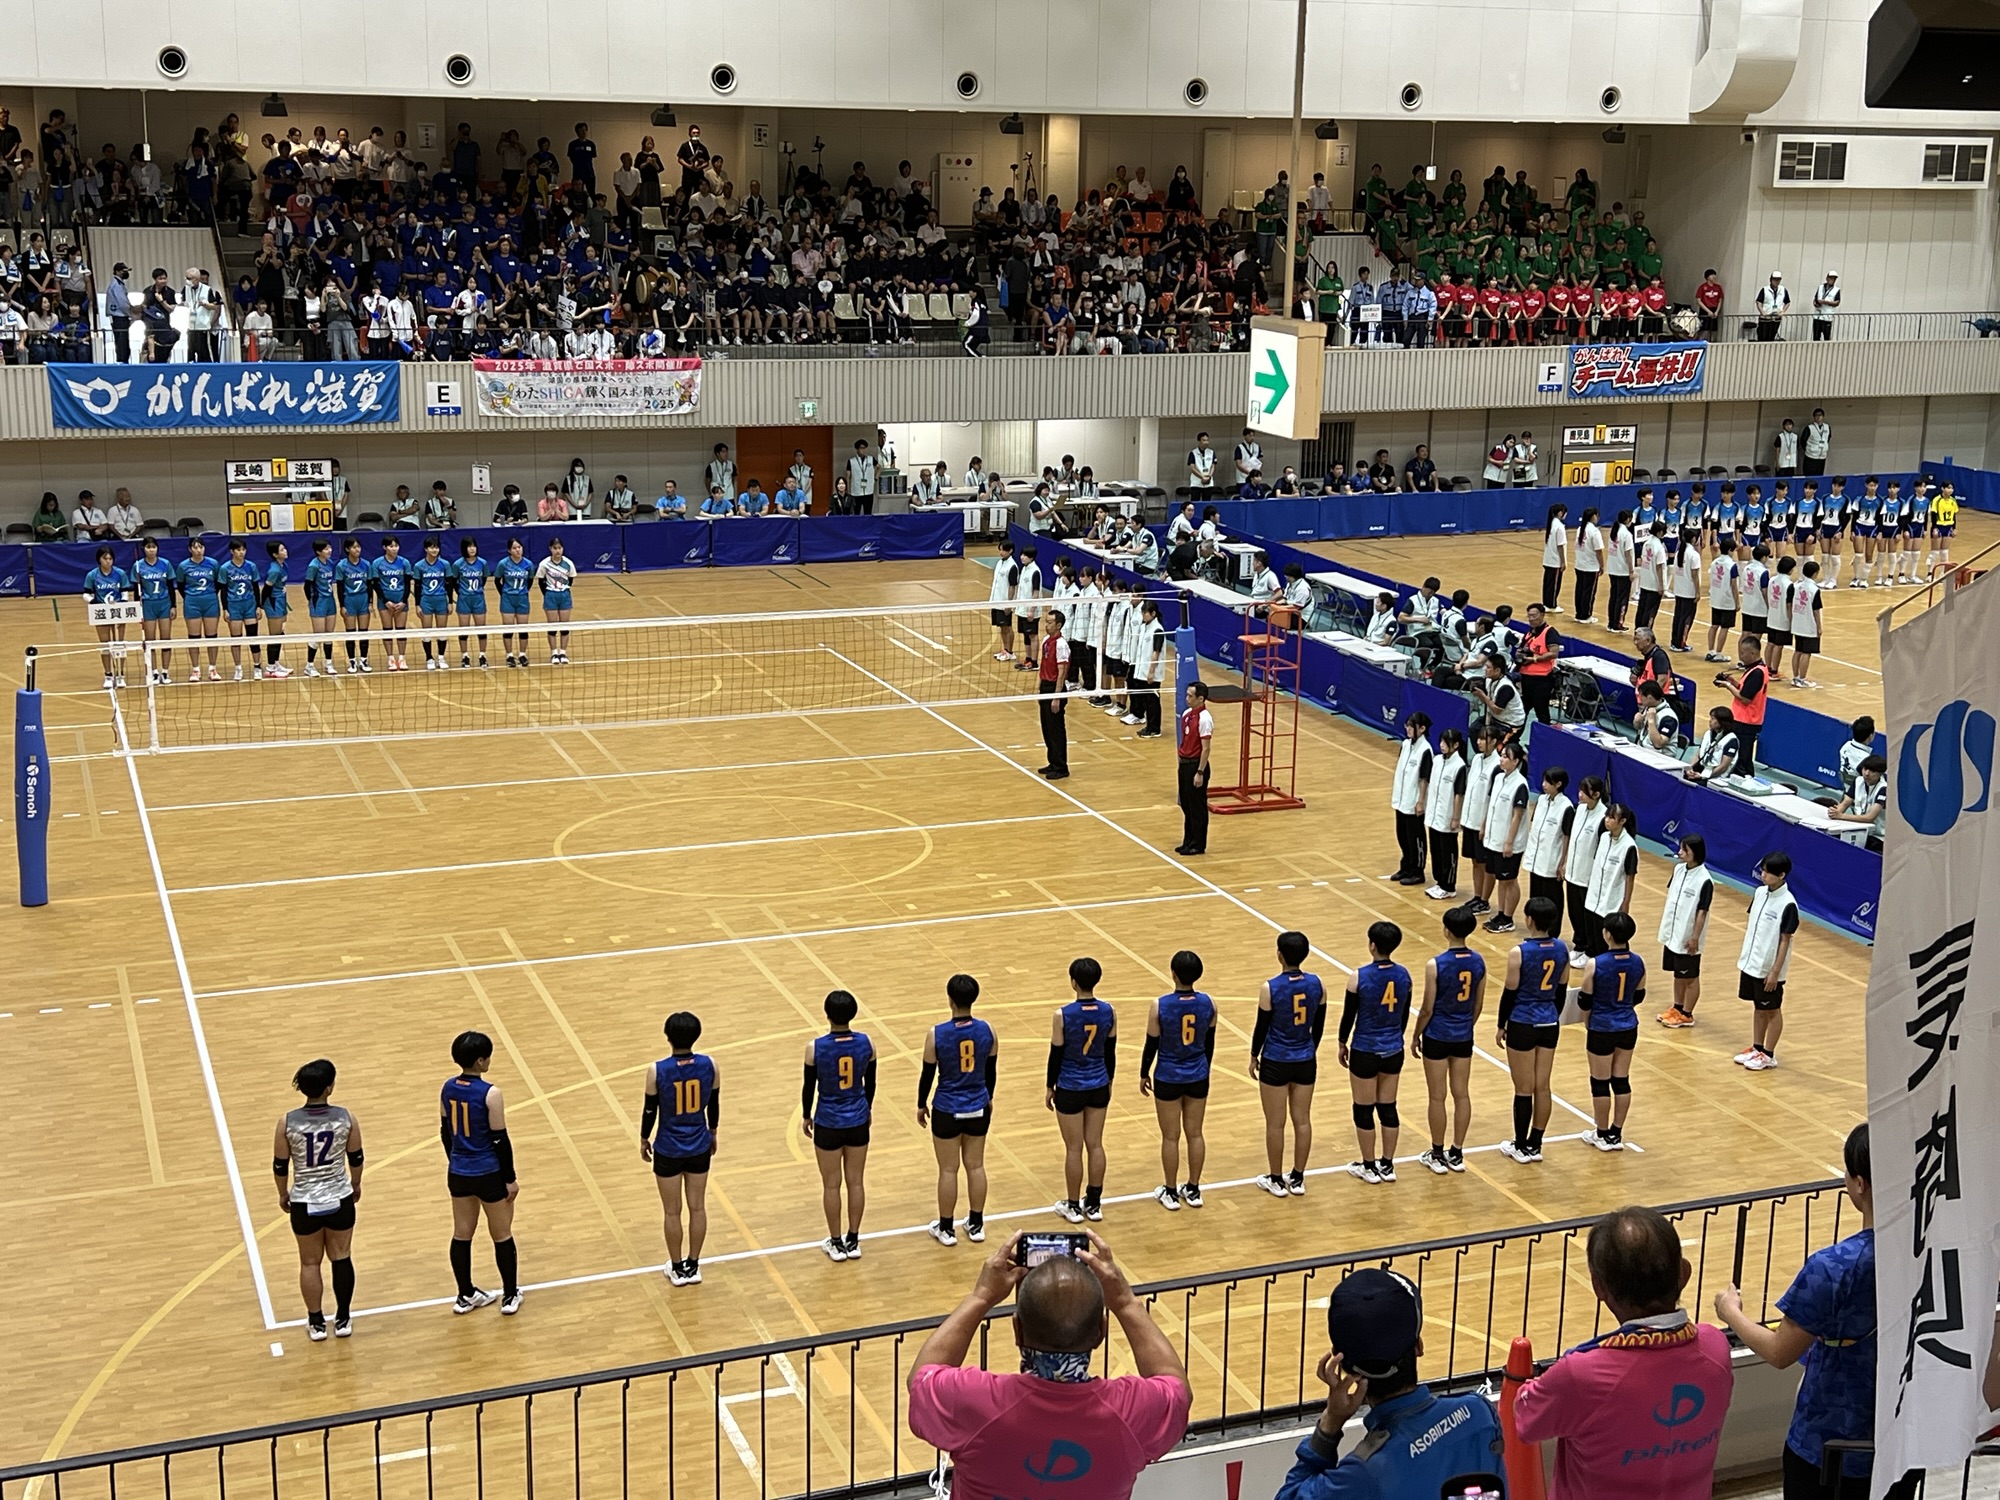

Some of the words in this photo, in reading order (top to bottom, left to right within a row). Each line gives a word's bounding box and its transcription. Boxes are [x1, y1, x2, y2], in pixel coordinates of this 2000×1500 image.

[495, 360, 536, 371] 2025年
[1547, 366, 1557, 381] F
[1572, 350, 1703, 394] チーム福井!!
[146, 367, 386, 418] がんばれ滋賀
[438, 385, 451, 403] E
[431, 407, 457, 415] コート
[644, 400, 674, 409] 2025
[1610, 429, 1630, 440] 福井
[234, 463, 263, 478] 長崎
[276, 463, 282, 476] 1
[295, 462, 324, 476] 滋賀
[245, 509, 271, 530] 00
[307, 507, 332, 528] 00
[1777, 512, 1784, 523] 6
[1801, 512, 1807, 523] 7
[1884, 512, 1894, 523] 10
[153, 580, 161, 594] 1
[197, 578, 207, 591] 2
[236, 582, 246, 595] 3
[353, 580, 363, 593] 7
[389, 577, 399, 590] 8
[428, 579, 438, 592] 9
[468, 578, 479, 591] 10
[94, 606, 138, 621] 滋賀県
[26, 777, 37, 818] Senoh
[1539, 959, 1556, 991] 2
[1457, 971, 1472, 1003] 3
[1617, 971, 1627, 1002] 1
[1380, 981, 1398, 1013] 4
[1293, 993, 1307, 1026] 5
[1181, 1014, 1197, 1046] 6
[1082, 1024, 1098, 1056] 7
[959, 1040, 975, 1074] 8
[838, 1056, 853, 1090] 9
[673, 1078, 701, 1115] 10
[448, 1098, 471, 1138] 11
[303, 1130, 335, 1168] 12
[1409, 1404, 1471, 1459] ASOBIIZUMU
